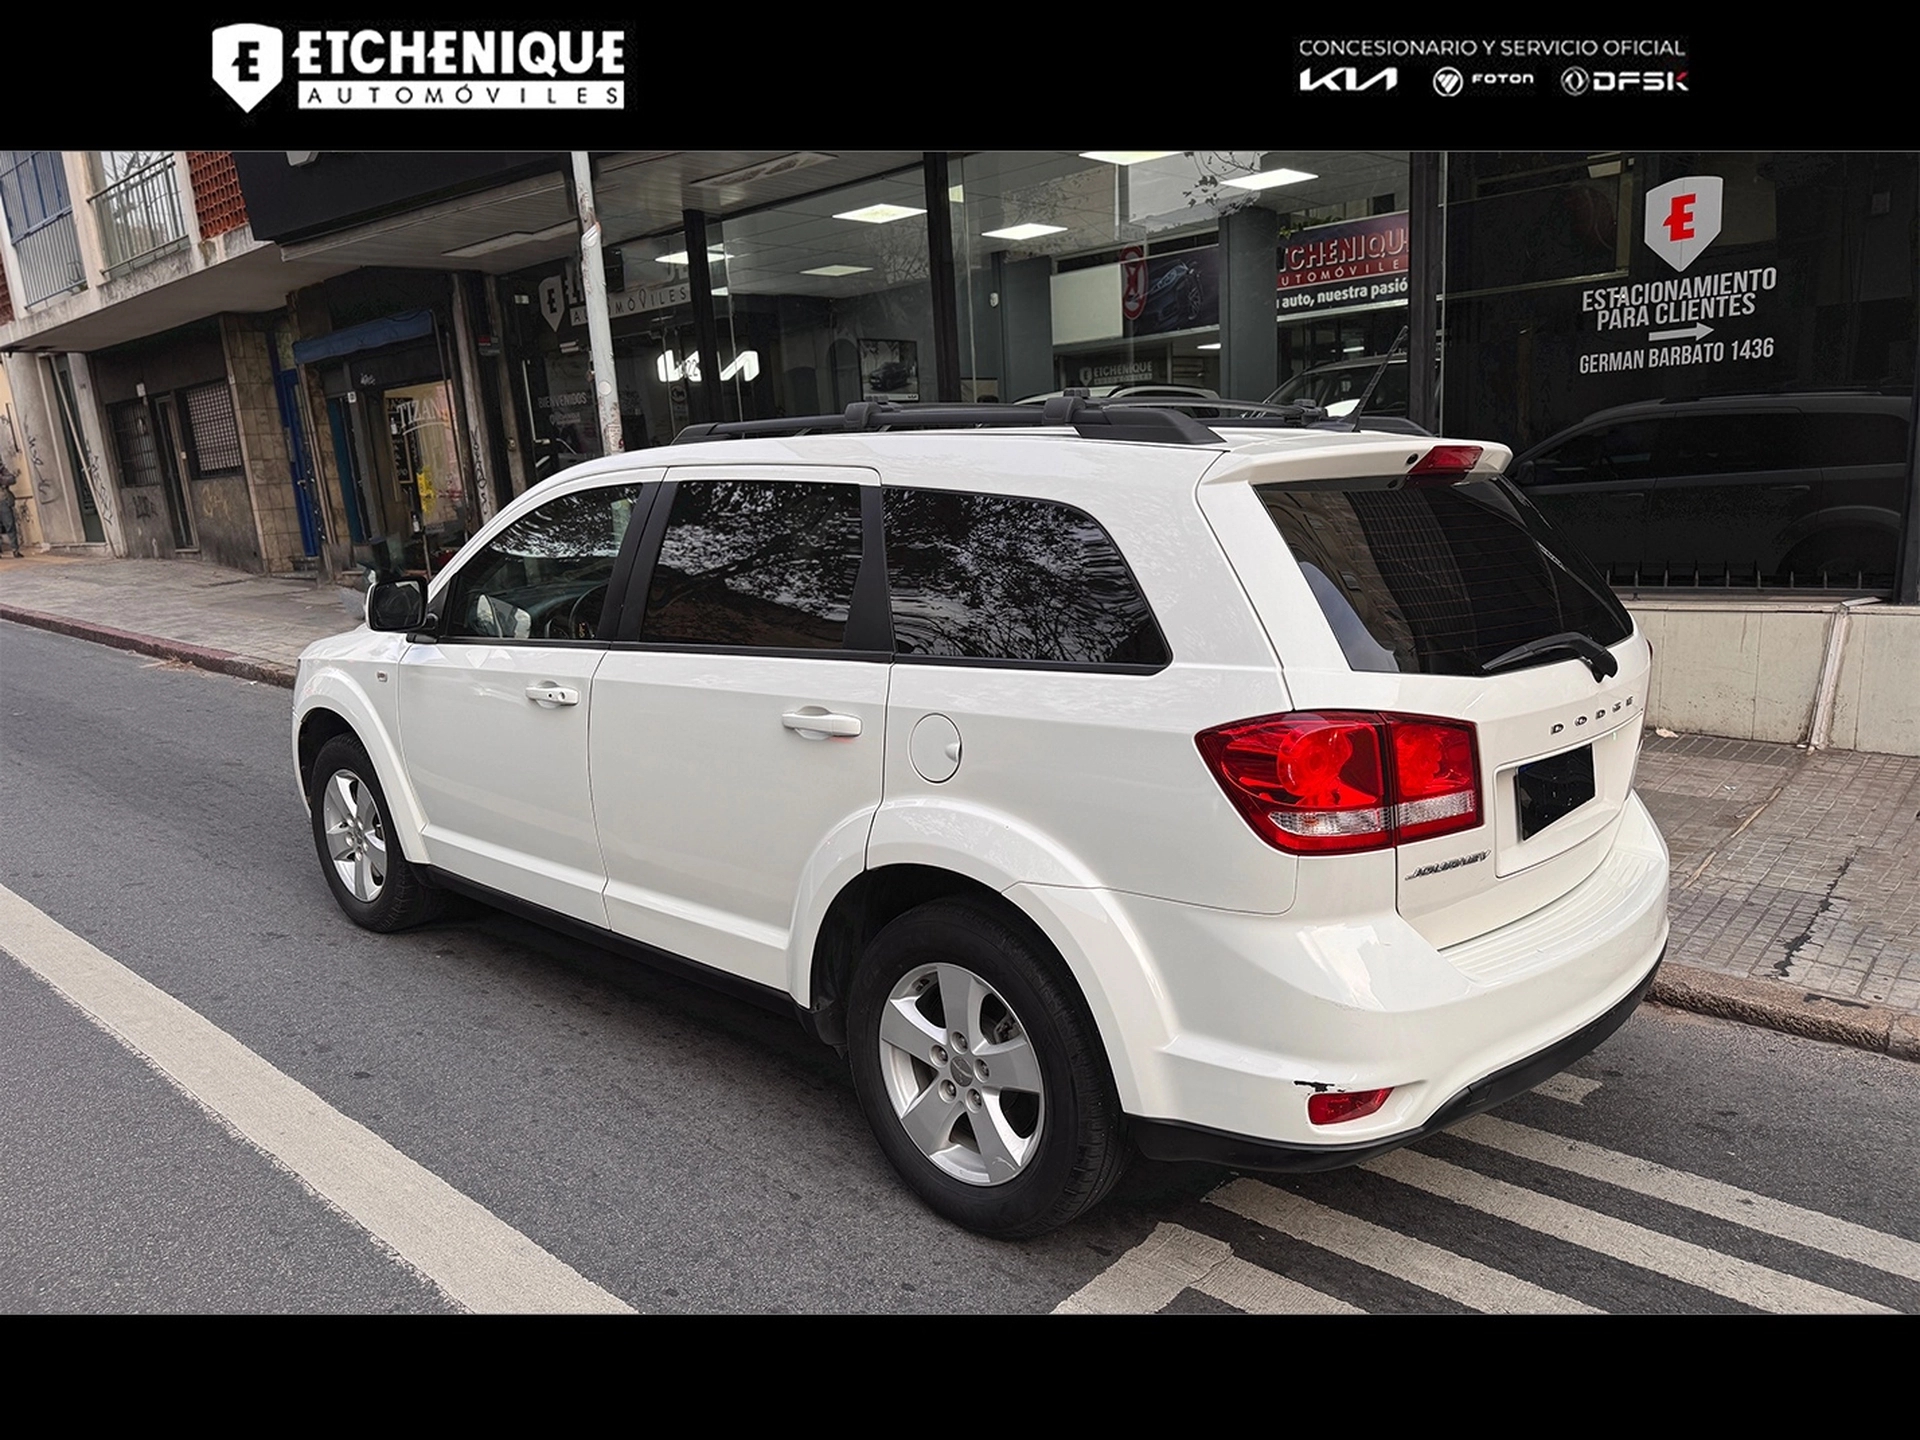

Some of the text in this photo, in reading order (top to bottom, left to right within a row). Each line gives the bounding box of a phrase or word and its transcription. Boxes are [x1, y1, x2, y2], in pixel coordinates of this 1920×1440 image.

[1279, 228, 1409, 273] TCHENIQU
[1281, 259, 1400, 287] UTOMÓVILE
[1582, 267, 1777, 312] ESTACIONAMIENTO
[1281, 293, 1315, 308] auto,
[1317, 285, 1368, 303] nuestra
[1371, 277, 1409, 299] pasió
[1597, 292, 1756, 331] PARA CLIENTES
[656, 350, 760, 382] KA
[1579, 337, 1775, 374] GERMAN BARBATO 1436
[1551, 696, 1635, 735] DODGE
[1404, 849, 1492, 881] JOURNEY
